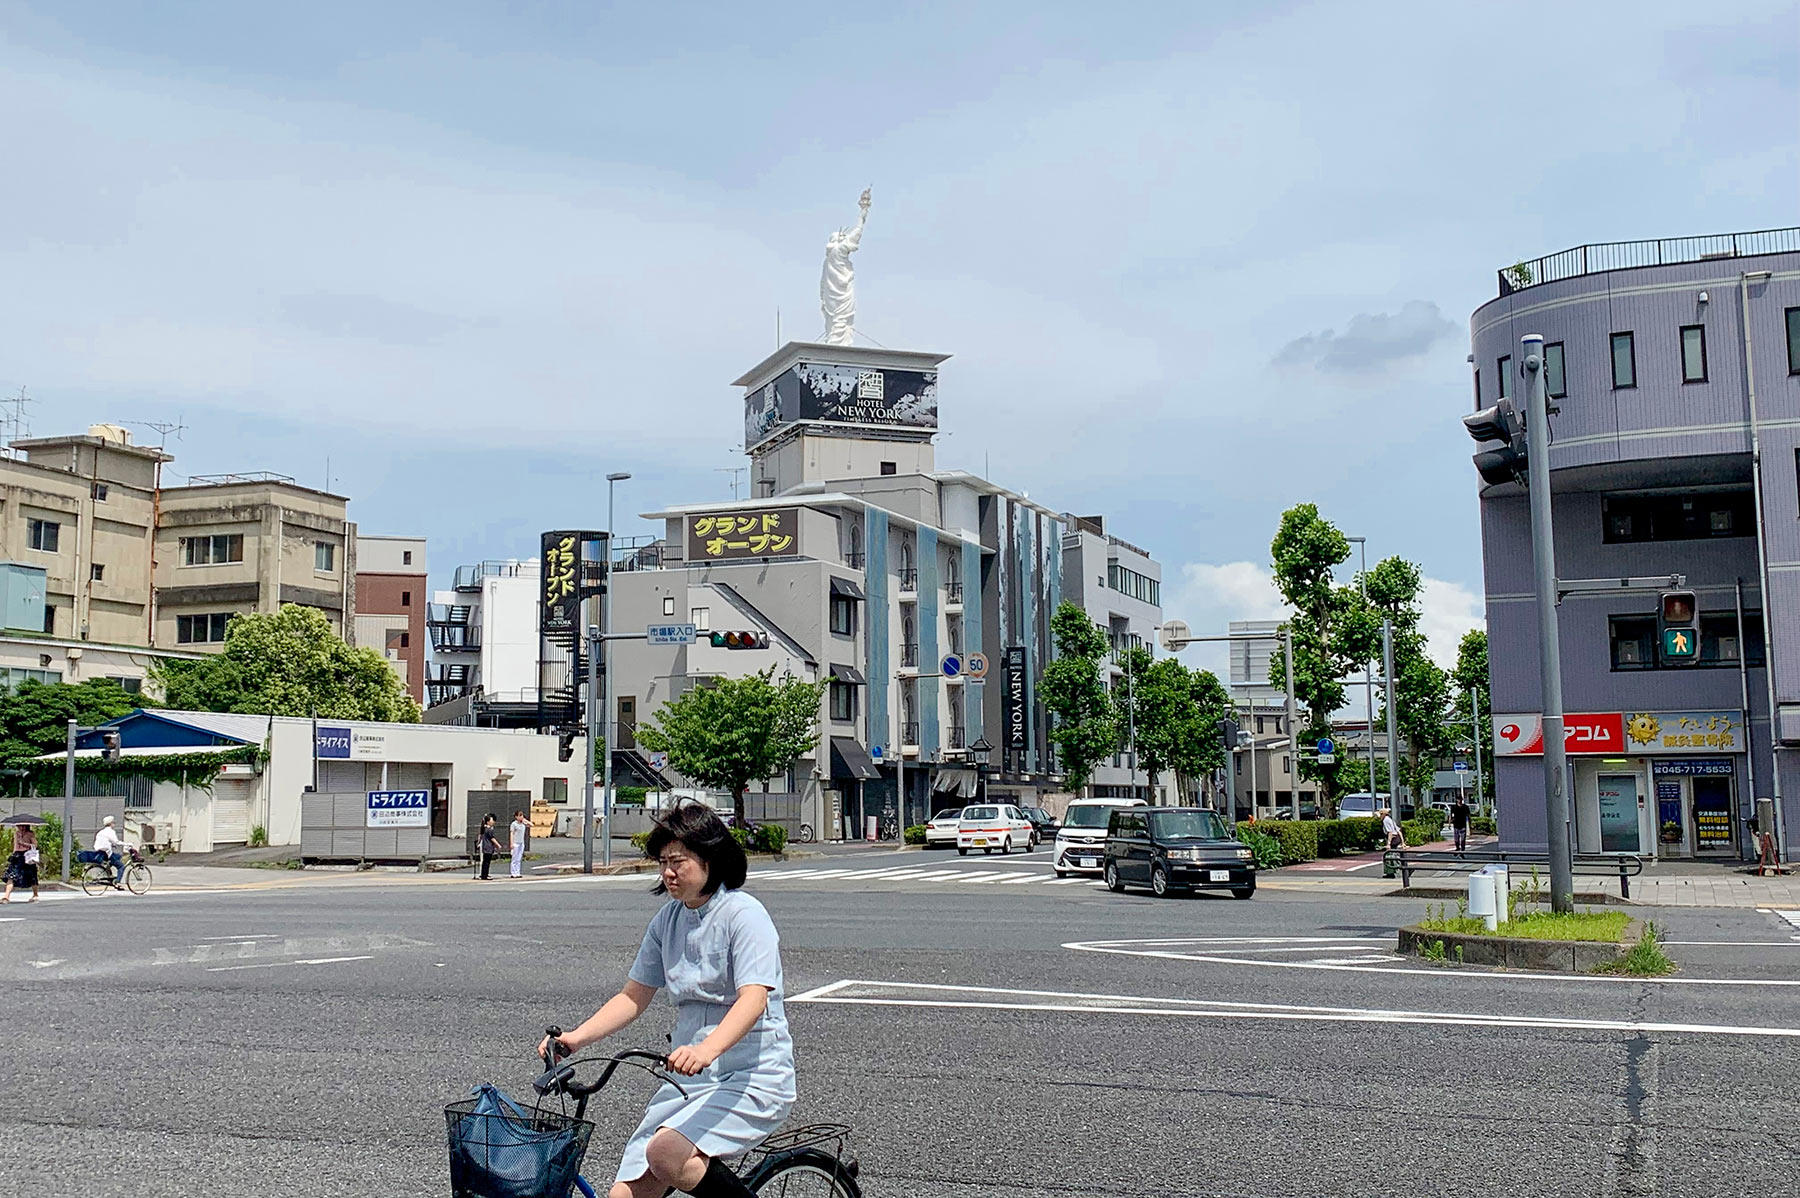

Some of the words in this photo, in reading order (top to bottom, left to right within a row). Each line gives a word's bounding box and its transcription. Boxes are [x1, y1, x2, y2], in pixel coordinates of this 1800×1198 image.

[838, 404, 866, 417] NEW
[869, 407, 902, 420] YORK
[856, 399, 884, 408] HOTEL
[694, 513, 780, 537] グランド
[706, 533, 793, 556] オープン
[559, 537, 576, 597] グランド
[547, 548, 560, 606] オープン
[650, 626, 693, 637] 市場駅入口
[969, 659, 984, 671] 50
[1011, 671, 1022, 701] NEW
[1012, 704, 1023, 741] YORK
[1564, 725, 1610, 740] アコム
[371, 792, 425, 807] ドライアイス
